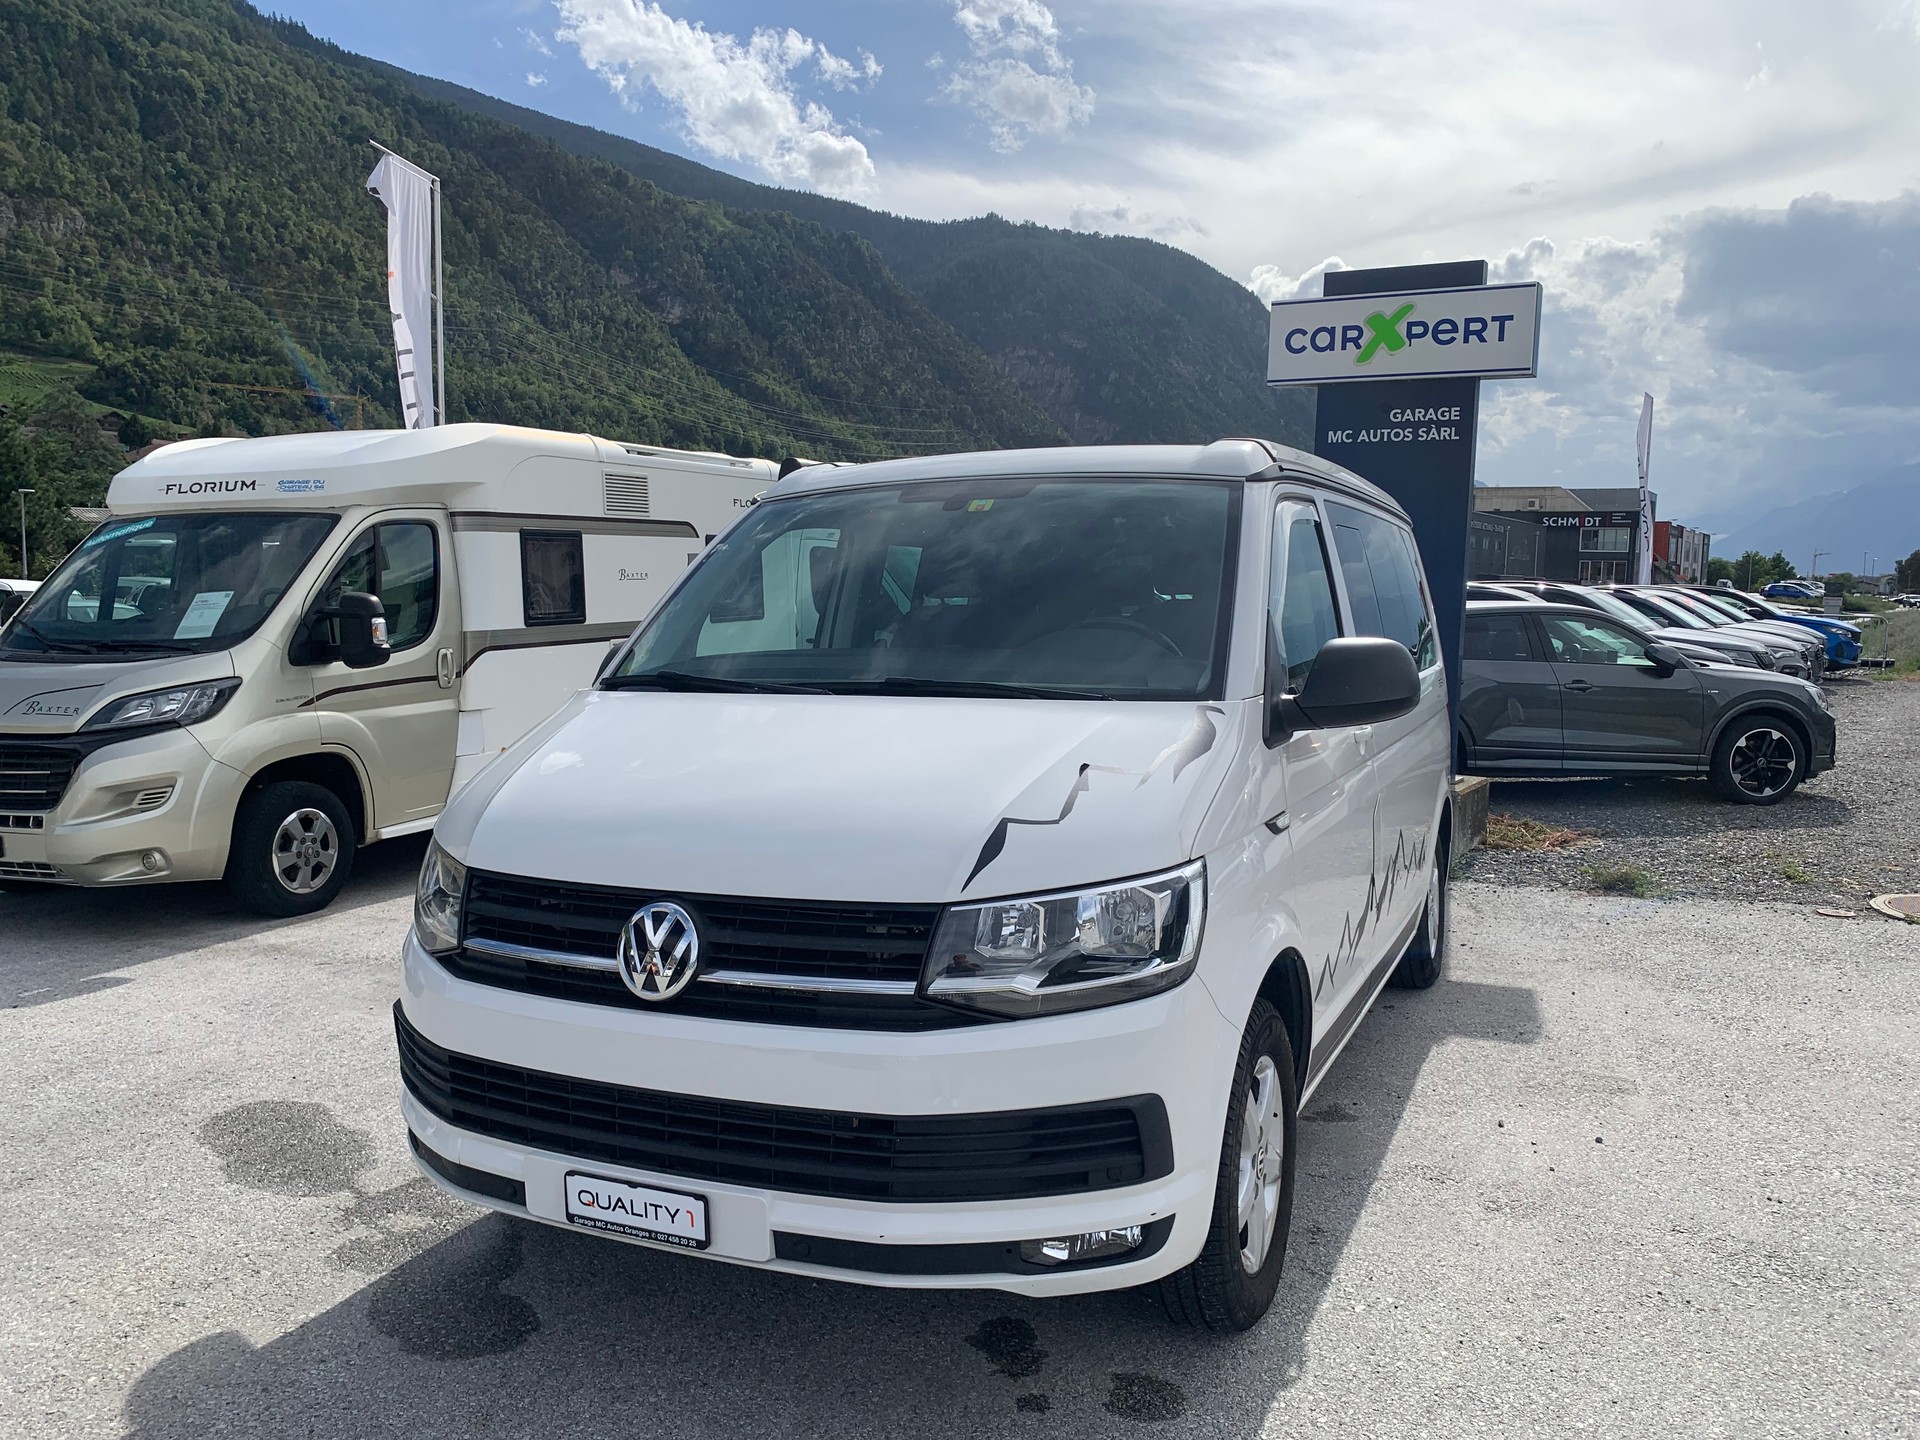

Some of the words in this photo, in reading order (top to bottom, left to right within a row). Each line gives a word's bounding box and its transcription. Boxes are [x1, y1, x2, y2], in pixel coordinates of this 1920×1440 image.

[1389, 407, 1461, 423] GARAGE
[1327, 430, 1353, 444] MC
[1357, 428, 1413, 443] AUTOS
[1418, 424, 1460, 442] SÀRL
[165, 480, 257, 495] FLORIUM
[1542, 515, 1601, 527] SCHMIDT
[85, 520, 154, 547] Automatique
[577, 1189, 680, 1224] QUALITY
[685, 1210, 695, 1228] 1
[573, 1216, 595, 1227] Garage
[595, 1220, 606, 1229] MC
[606, 1223, 624, 1232] Autos
[624, 1226, 650, 1238] Granges
[657, 1233, 668, 1241] 027
[680, 1238, 688, 1246] 20
